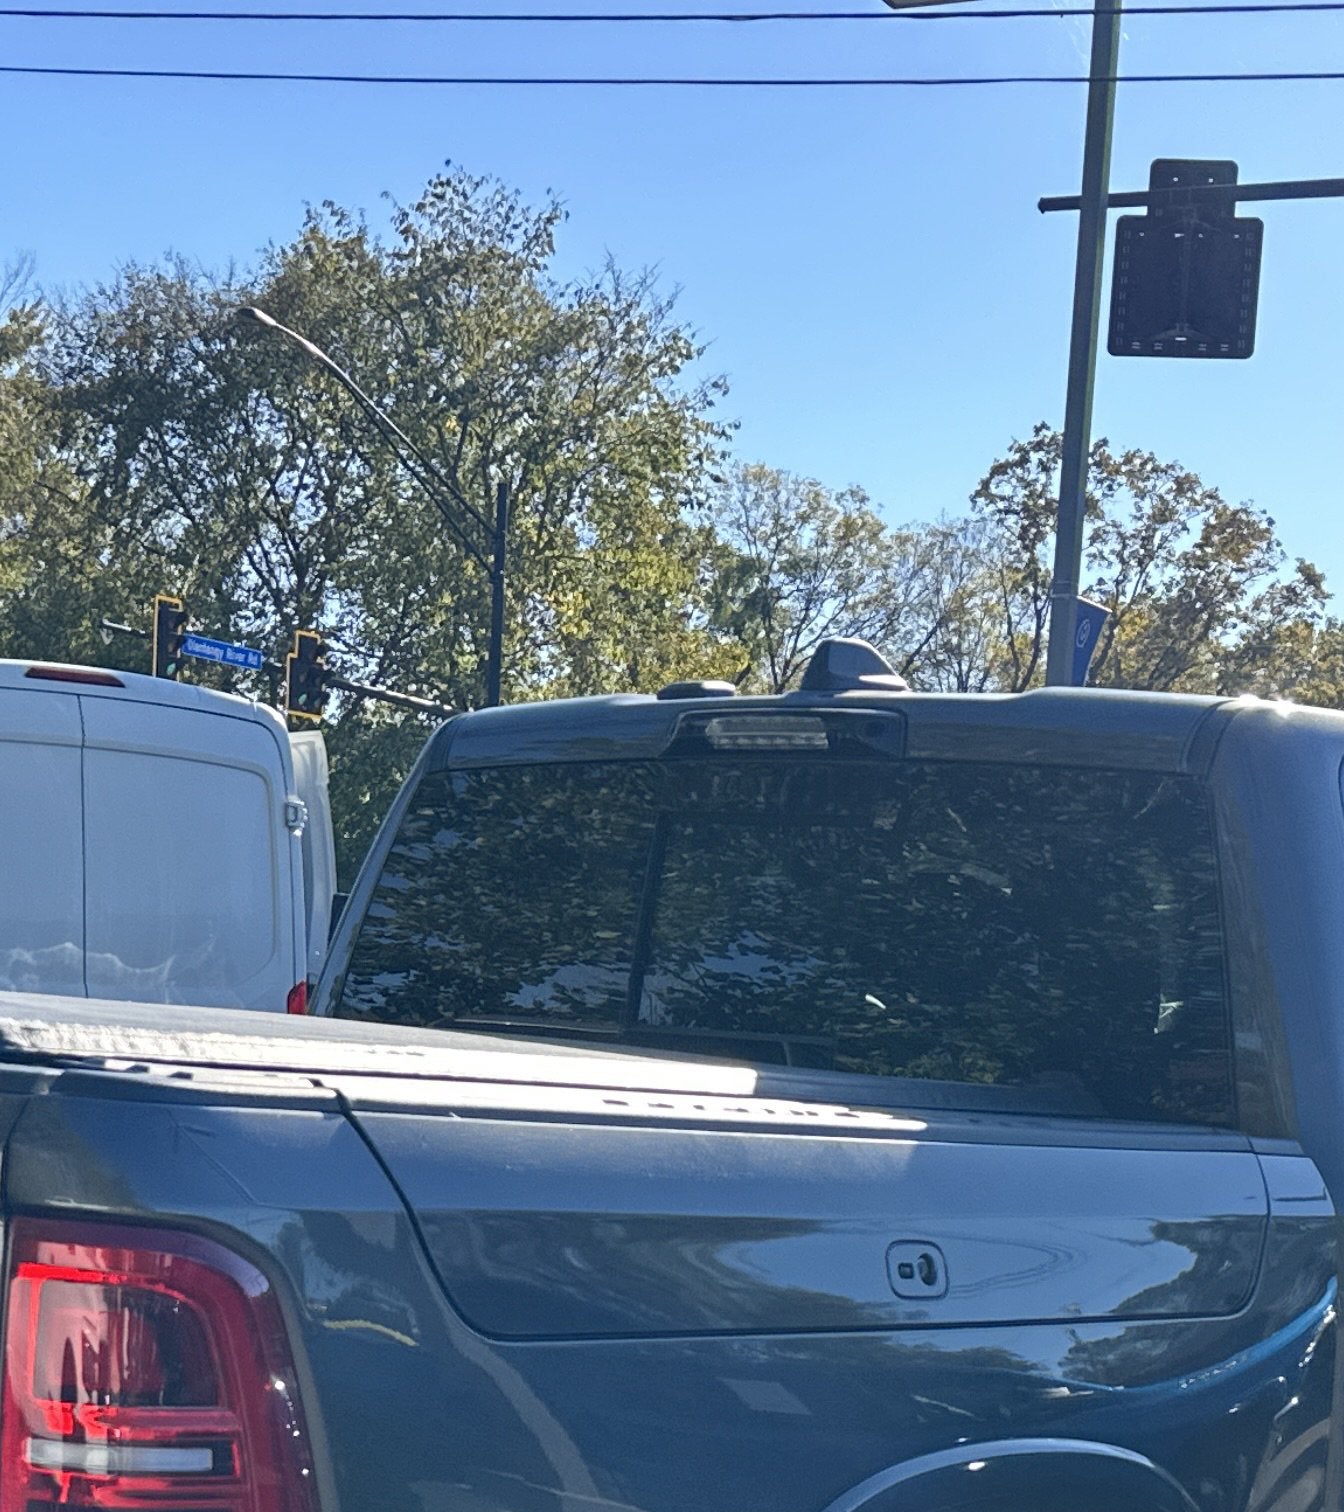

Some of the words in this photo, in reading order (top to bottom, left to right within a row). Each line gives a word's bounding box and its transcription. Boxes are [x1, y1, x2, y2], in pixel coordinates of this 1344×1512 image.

[188, 638, 224, 661] Olentangy
[226, 647, 246, 662] River
[248, 652, 258, 666] Rd
